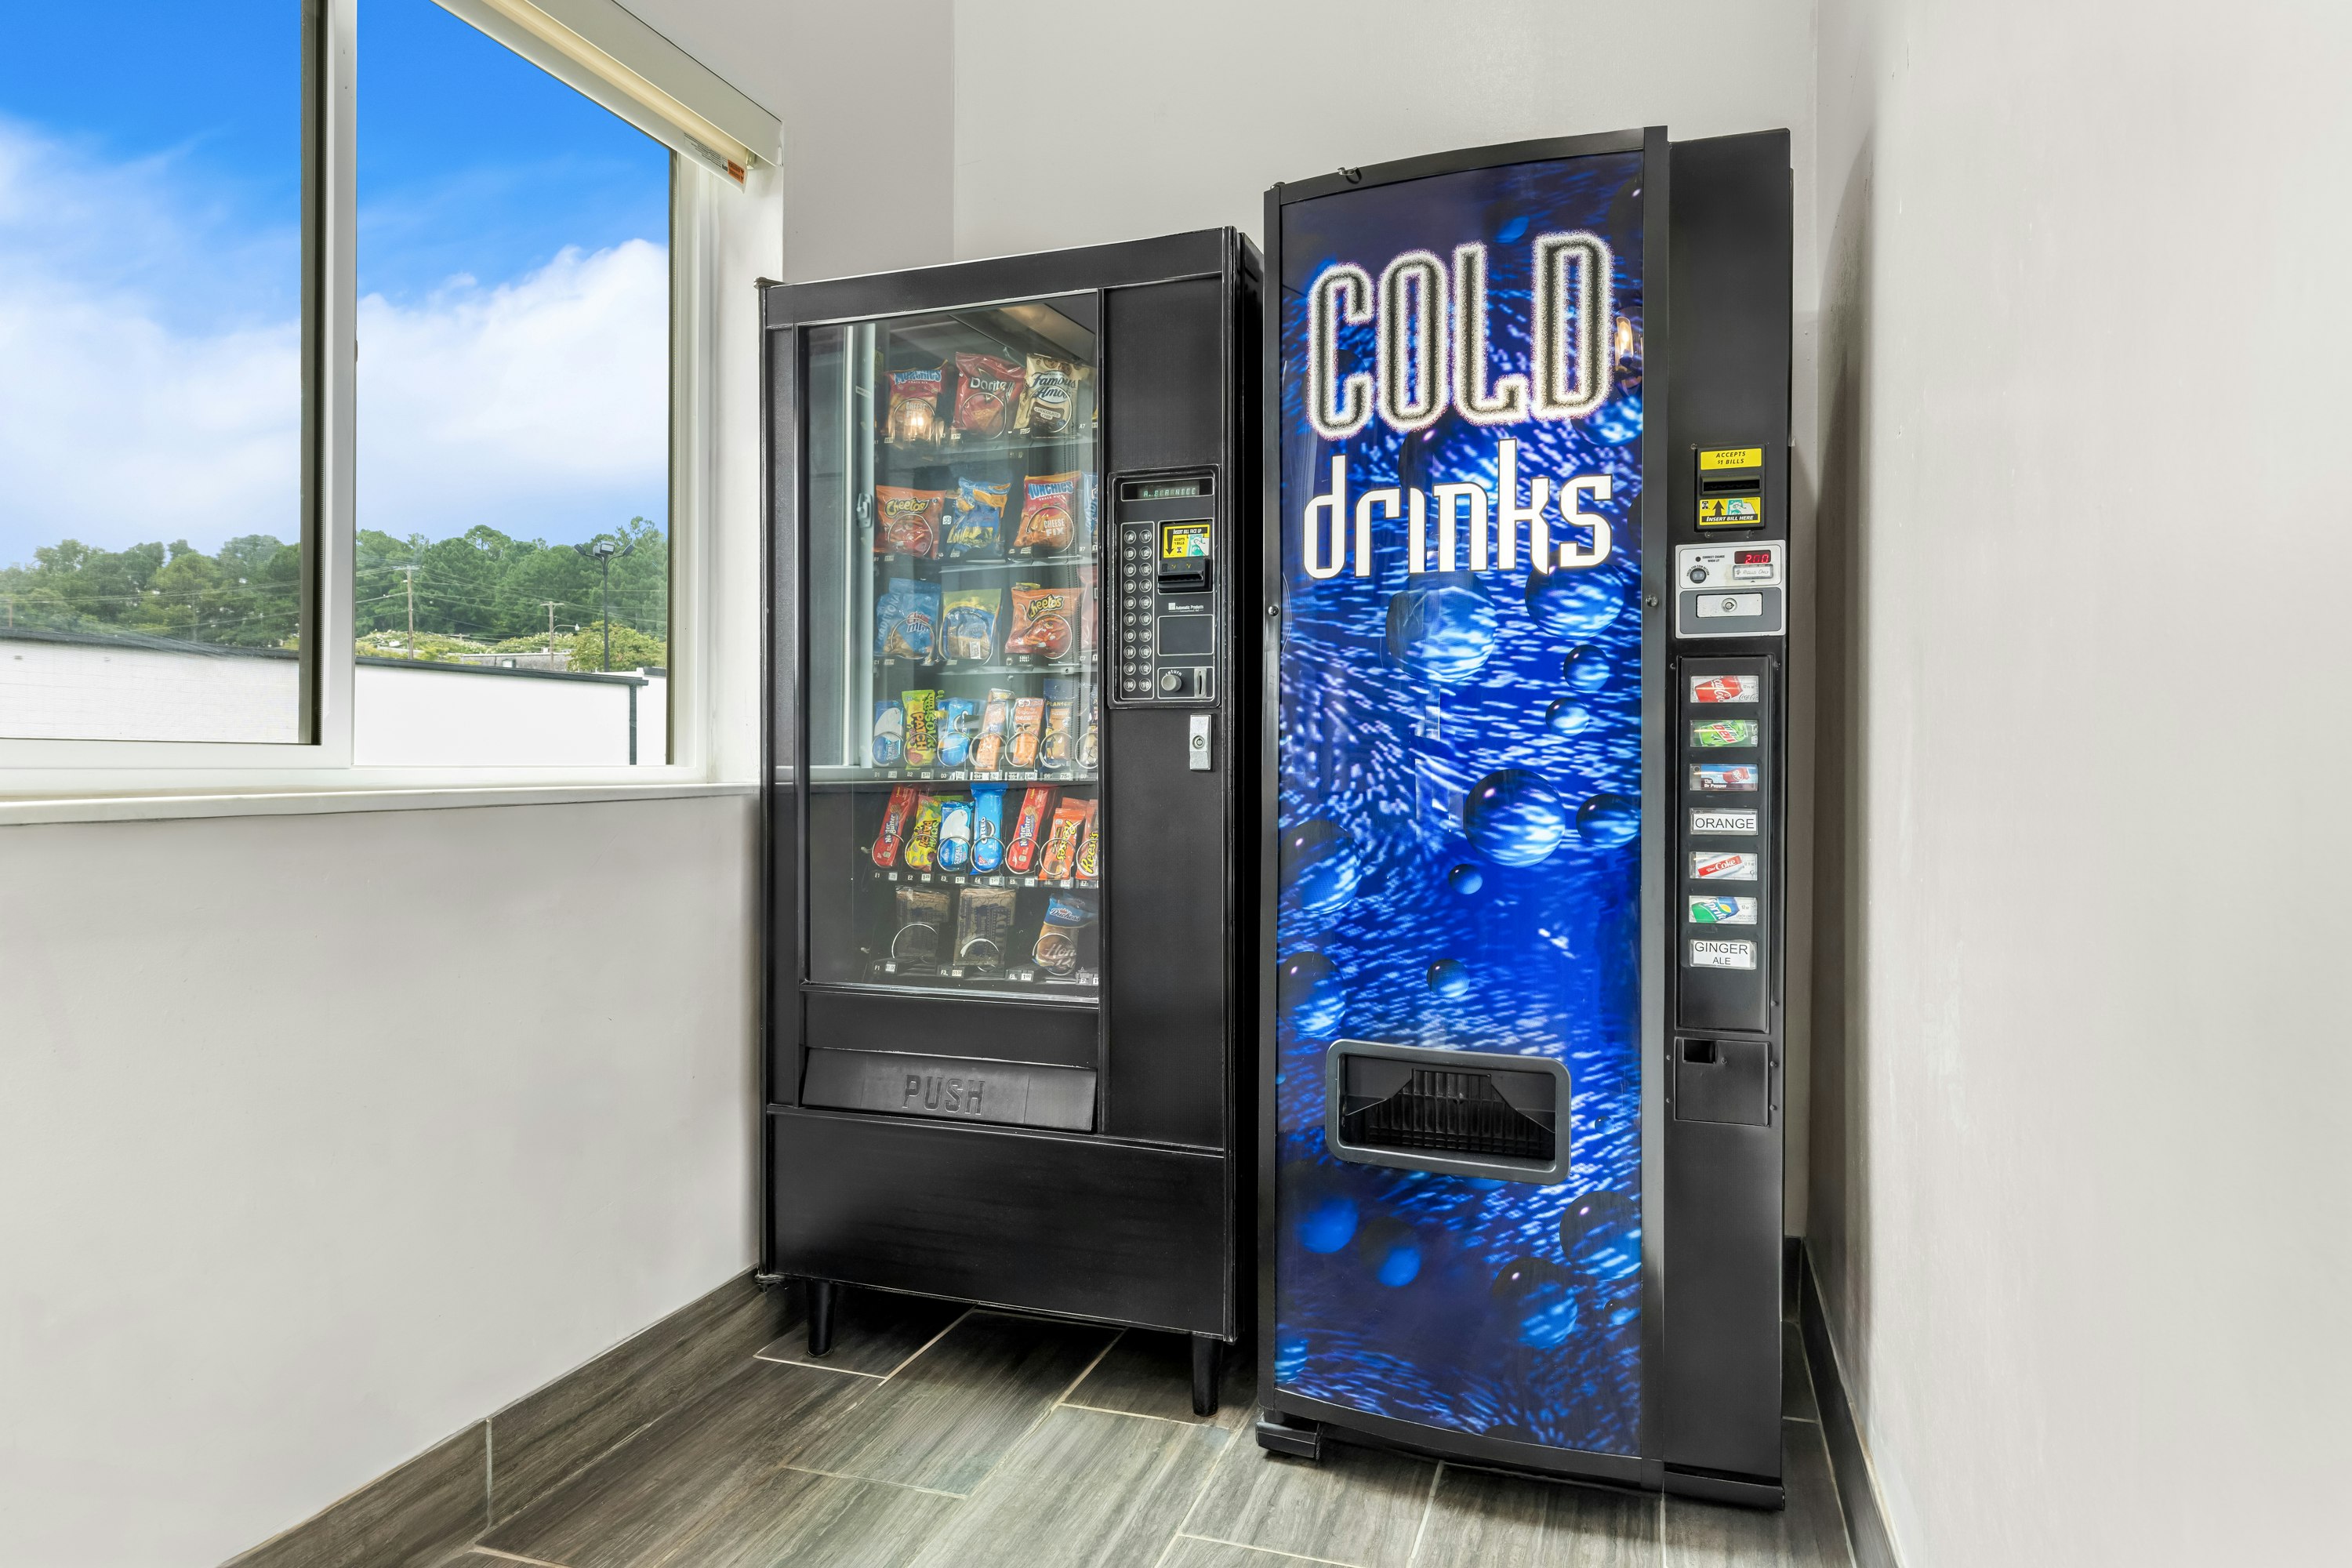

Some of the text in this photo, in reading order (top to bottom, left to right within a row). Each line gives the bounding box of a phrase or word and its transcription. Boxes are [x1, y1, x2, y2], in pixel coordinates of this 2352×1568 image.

[1308, 230, 1613, 441] COLD
[1029, 371, 1077, 389] Famous
[885, 498, 927, 517] Cheetos
[1304, 438, 1613, 579] drinks
[1044, 518, 1065, 529] CHEESE
[1045, 528, 1065, 537] FIX
[912, 711, 927, 751] PATCH
[1695, 818, 1755, 829] ORANGE
[1715, 859, 1736, 870] Coke
[1050, 908, 1081, 922] Duchess
[1695, 942, 1748, 955] GINGER
[1712, 956, 1731, 965] ALE
[902, 1074, 985, 1116] PUSH
